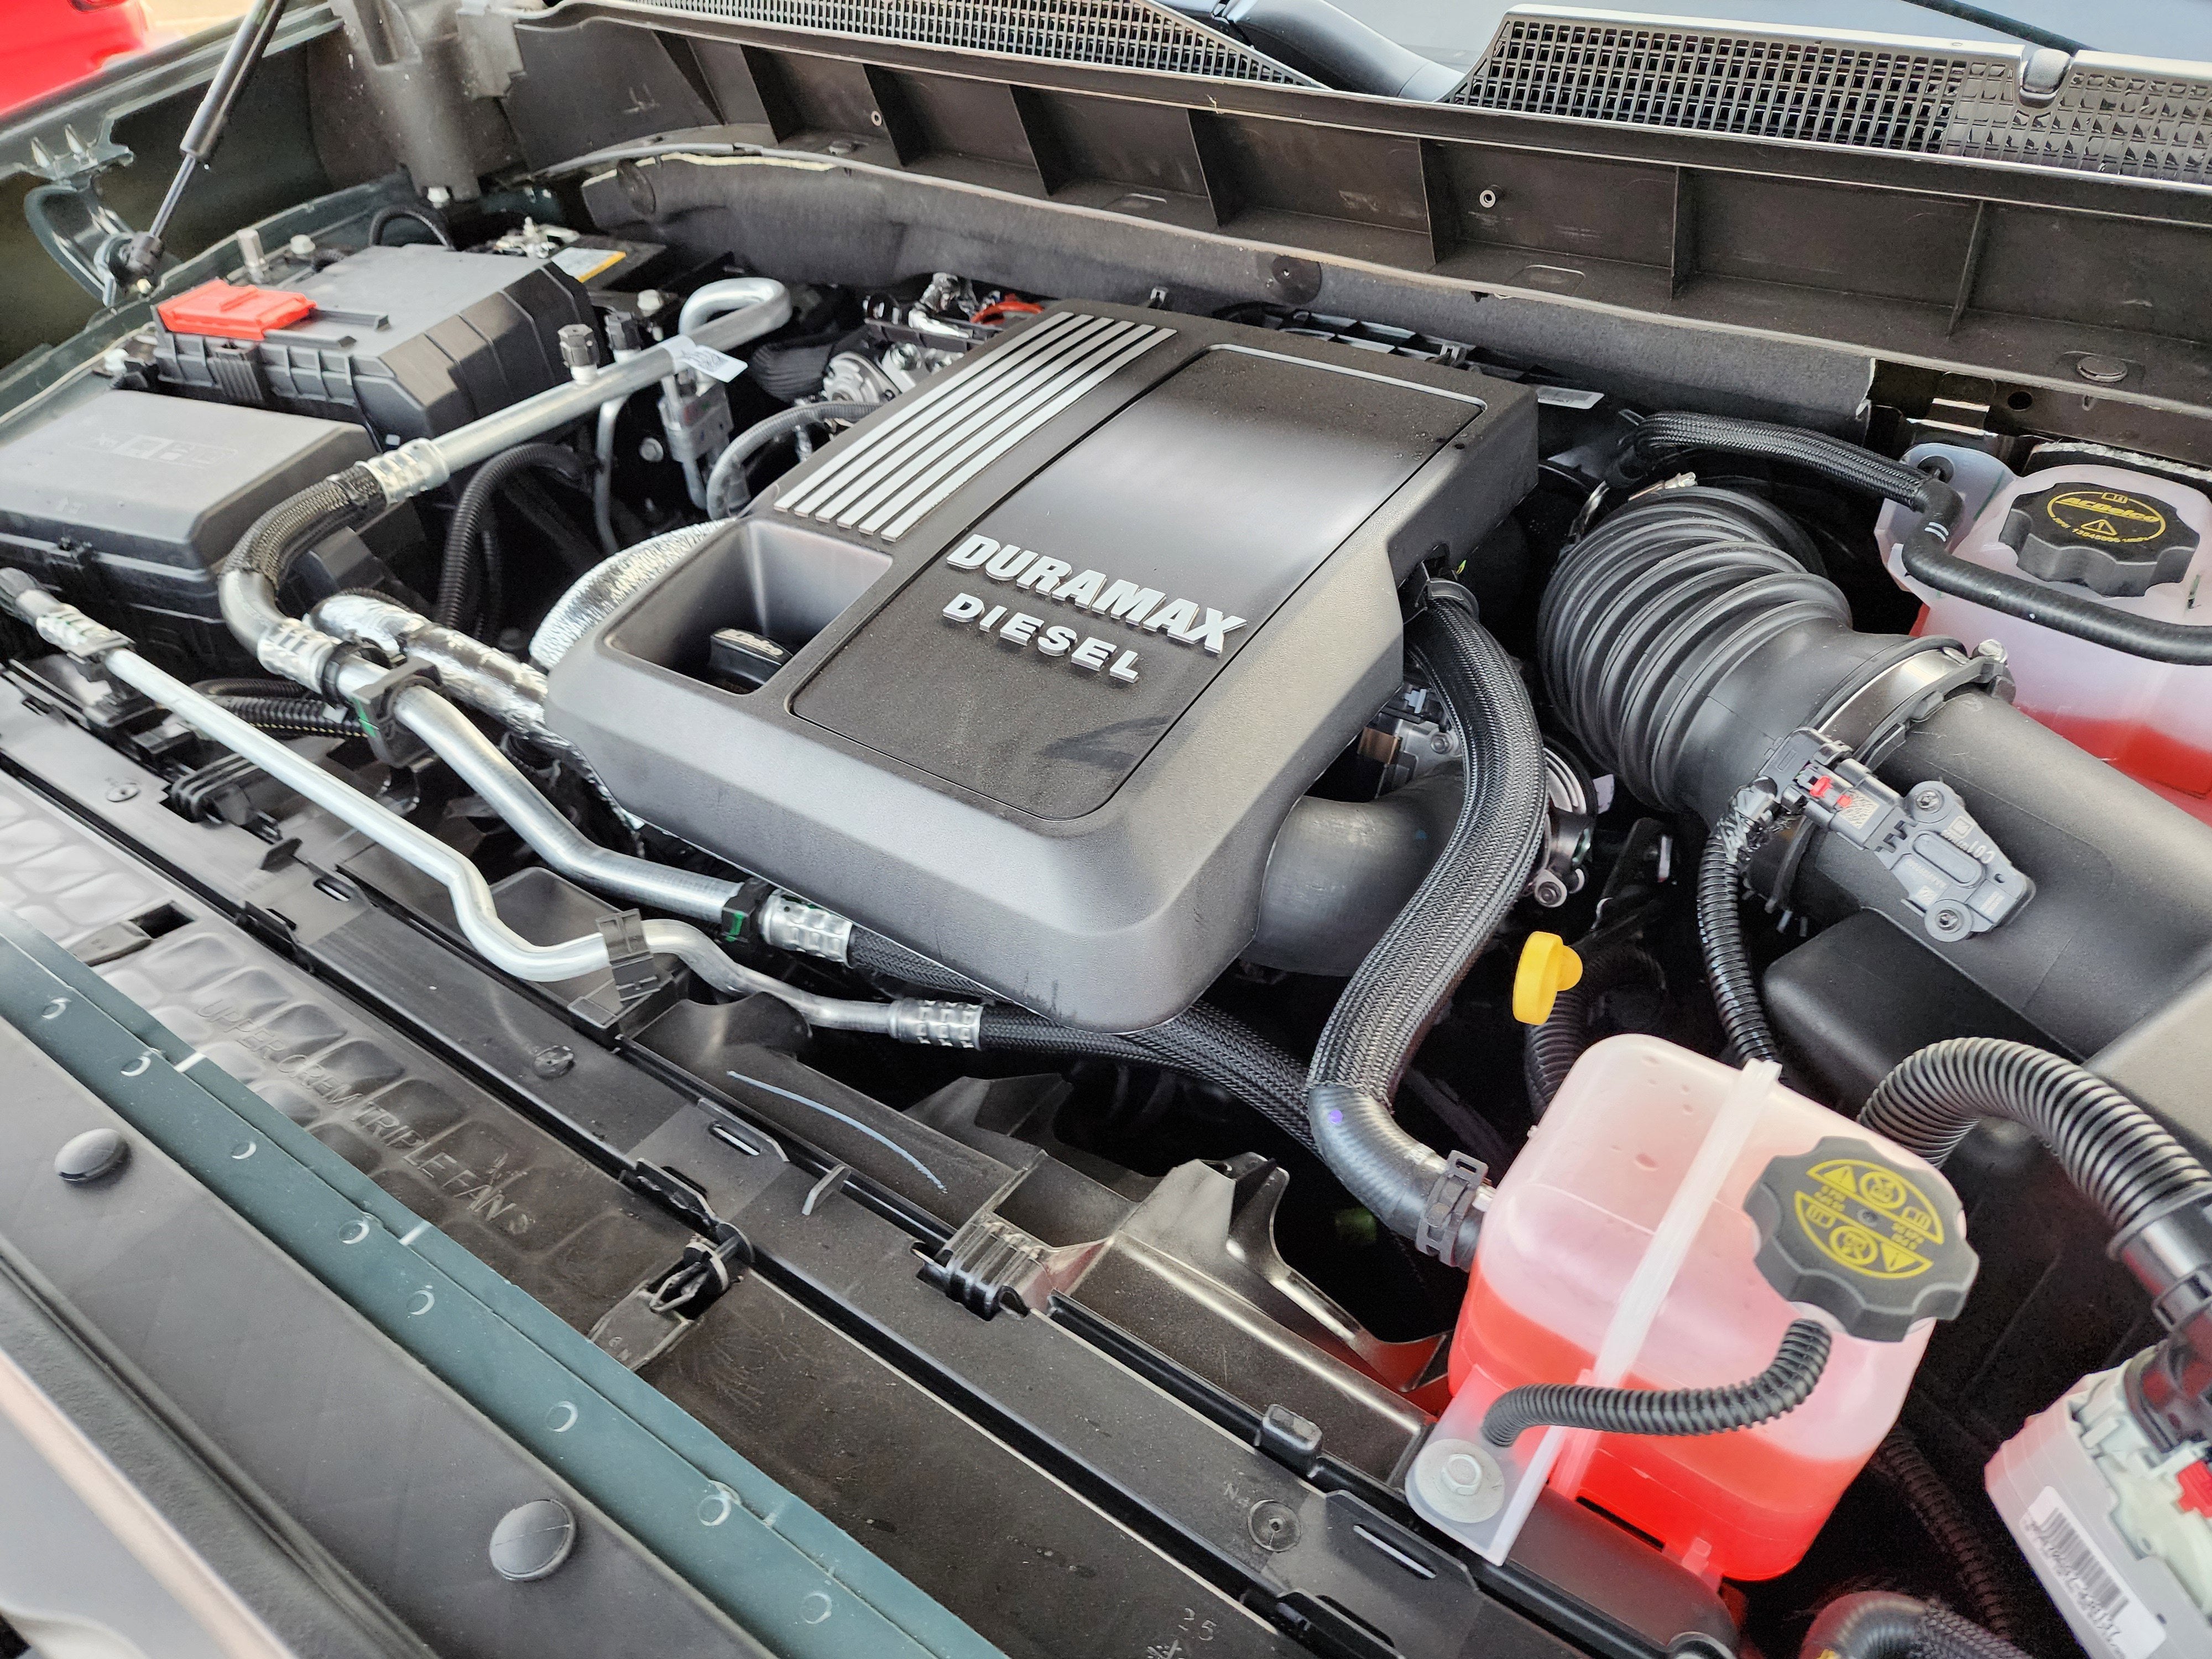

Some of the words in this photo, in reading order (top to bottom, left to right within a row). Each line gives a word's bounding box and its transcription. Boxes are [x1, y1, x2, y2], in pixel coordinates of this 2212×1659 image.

[942, 593, 1140, 684] DIESEL
[946, 534, 1247, 654] DURAMAX
[196, 1000, 286, 1060] UPPER
[351, 1101, 457, 1178] TRIPLE
